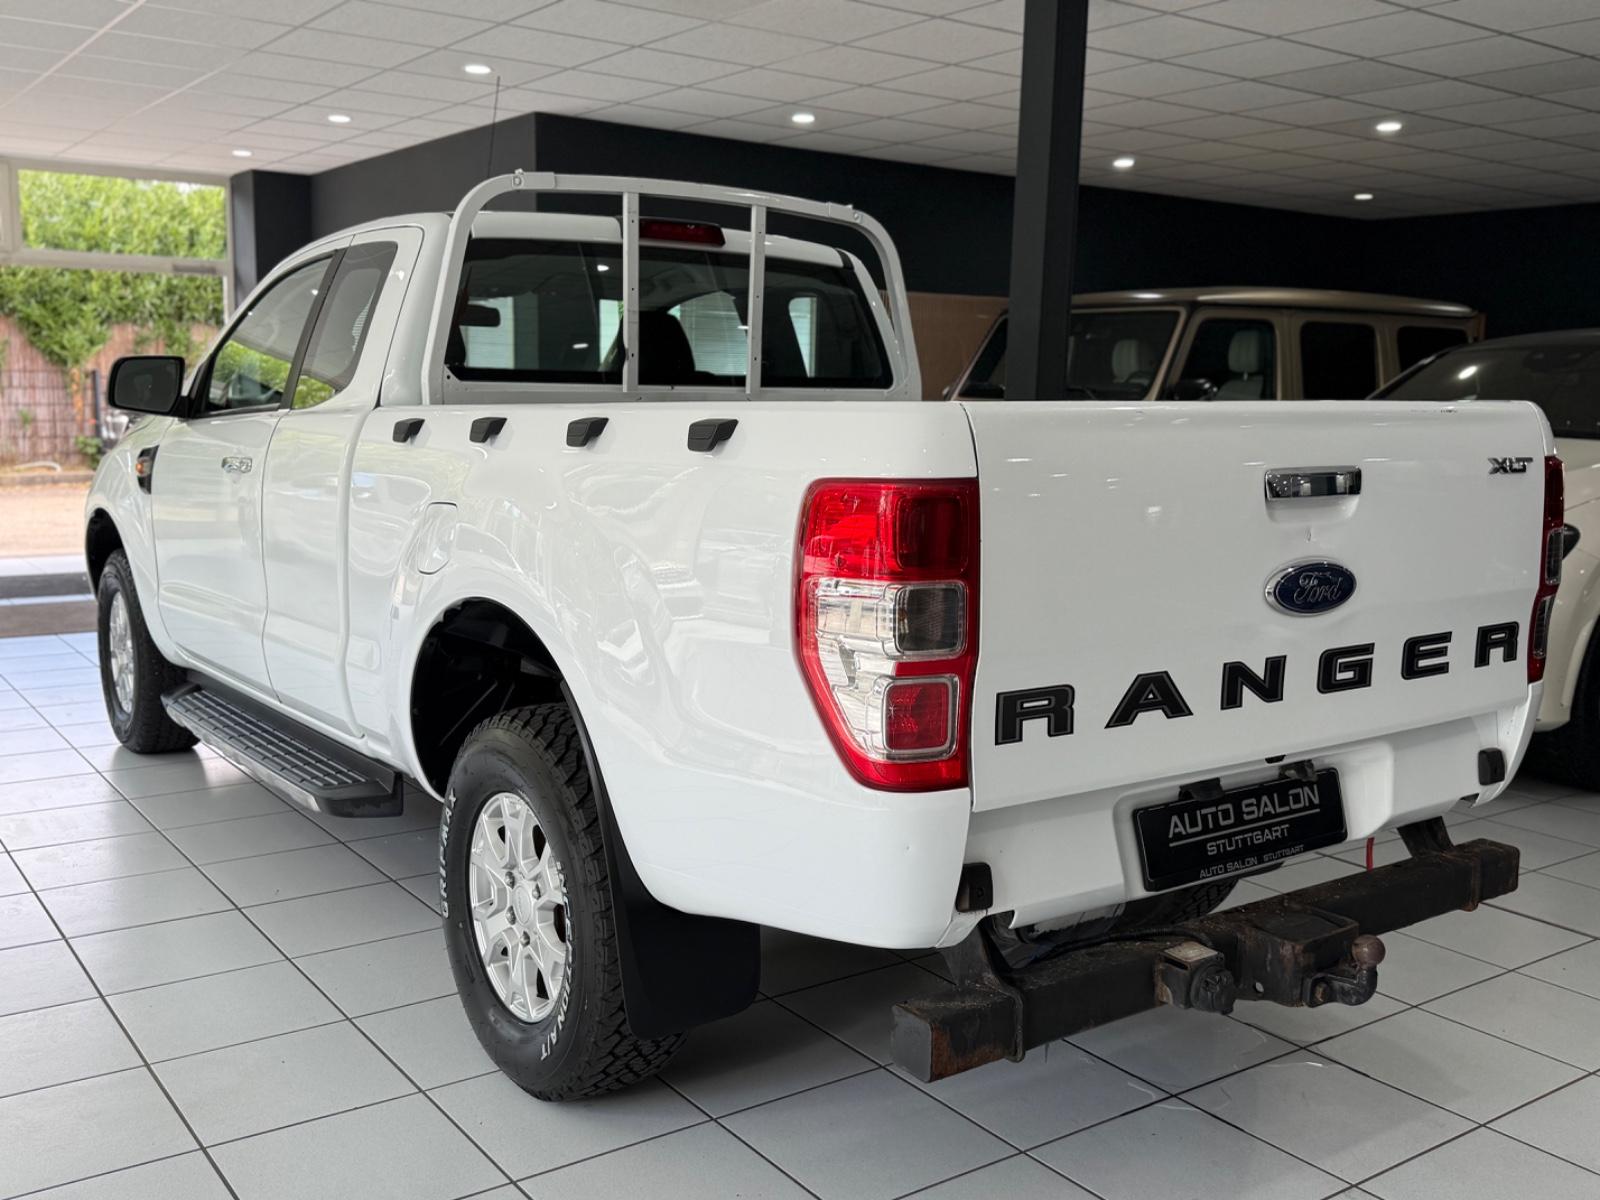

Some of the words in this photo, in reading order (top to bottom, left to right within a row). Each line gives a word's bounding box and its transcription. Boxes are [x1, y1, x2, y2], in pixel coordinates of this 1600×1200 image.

[1488, 457, 1534, 474] XLT
[1293, 571, 1344, 605] Ford
[995, 621, 1520, 746] RANGER
[1168, 803, 1235, 839] AUTO
[1241, 784, 1320, 822] SALON
[439, 787, 457, 919] GRIPMAX
[1207, 824, 1291, 856] STUTTGART
[1199, 864, 1225, 879] AUTO
[1226, 856, 1259, 872] SALON
[1263, 844, 1305, 862] STUTTGART
